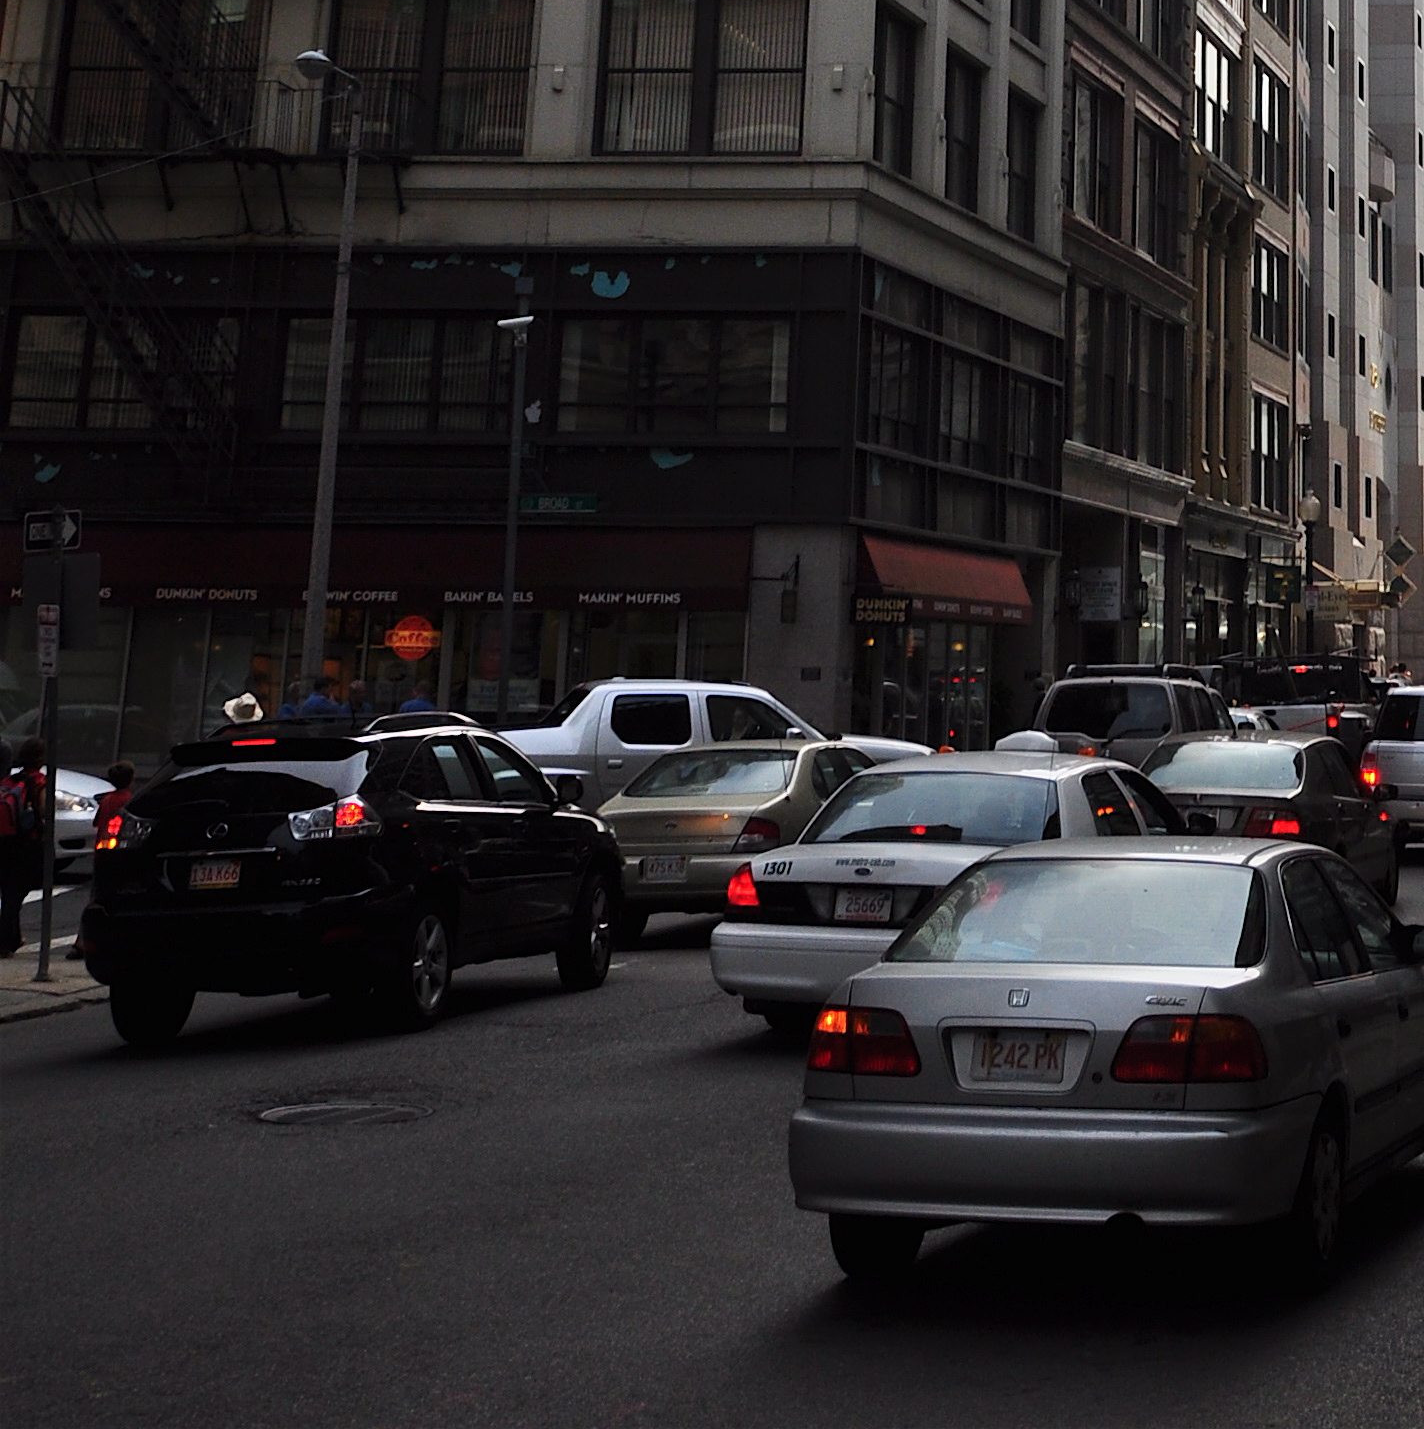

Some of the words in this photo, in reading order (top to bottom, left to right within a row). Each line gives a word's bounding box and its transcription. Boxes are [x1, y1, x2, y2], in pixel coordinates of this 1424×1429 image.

[537, 496, 569, 510] BROAD
[155, 588, 206, 600] DUNKIN'
[208, 589, 258, 601] DONUTS
[353, 591, 399, 602] COFFEE
[444, 591, 483, 603] BAKIN'
[487, 591, 534, 603] BAELS
[578, 592, 624, 604] MAKIN'
[626, 593, 681, 605] MUFFINS
[856, 597, 909, 610] DUNKIN'
[855, 610, 906, 622] DONUTS
[387, 632, 439, 645] Coffee
[763, 861, 793, 876] 1301
[845, 896, 884, 913] 25669
[981, 1042, 1029, 1069] 1242
[1035, 1043, 1061, 1070] PK
